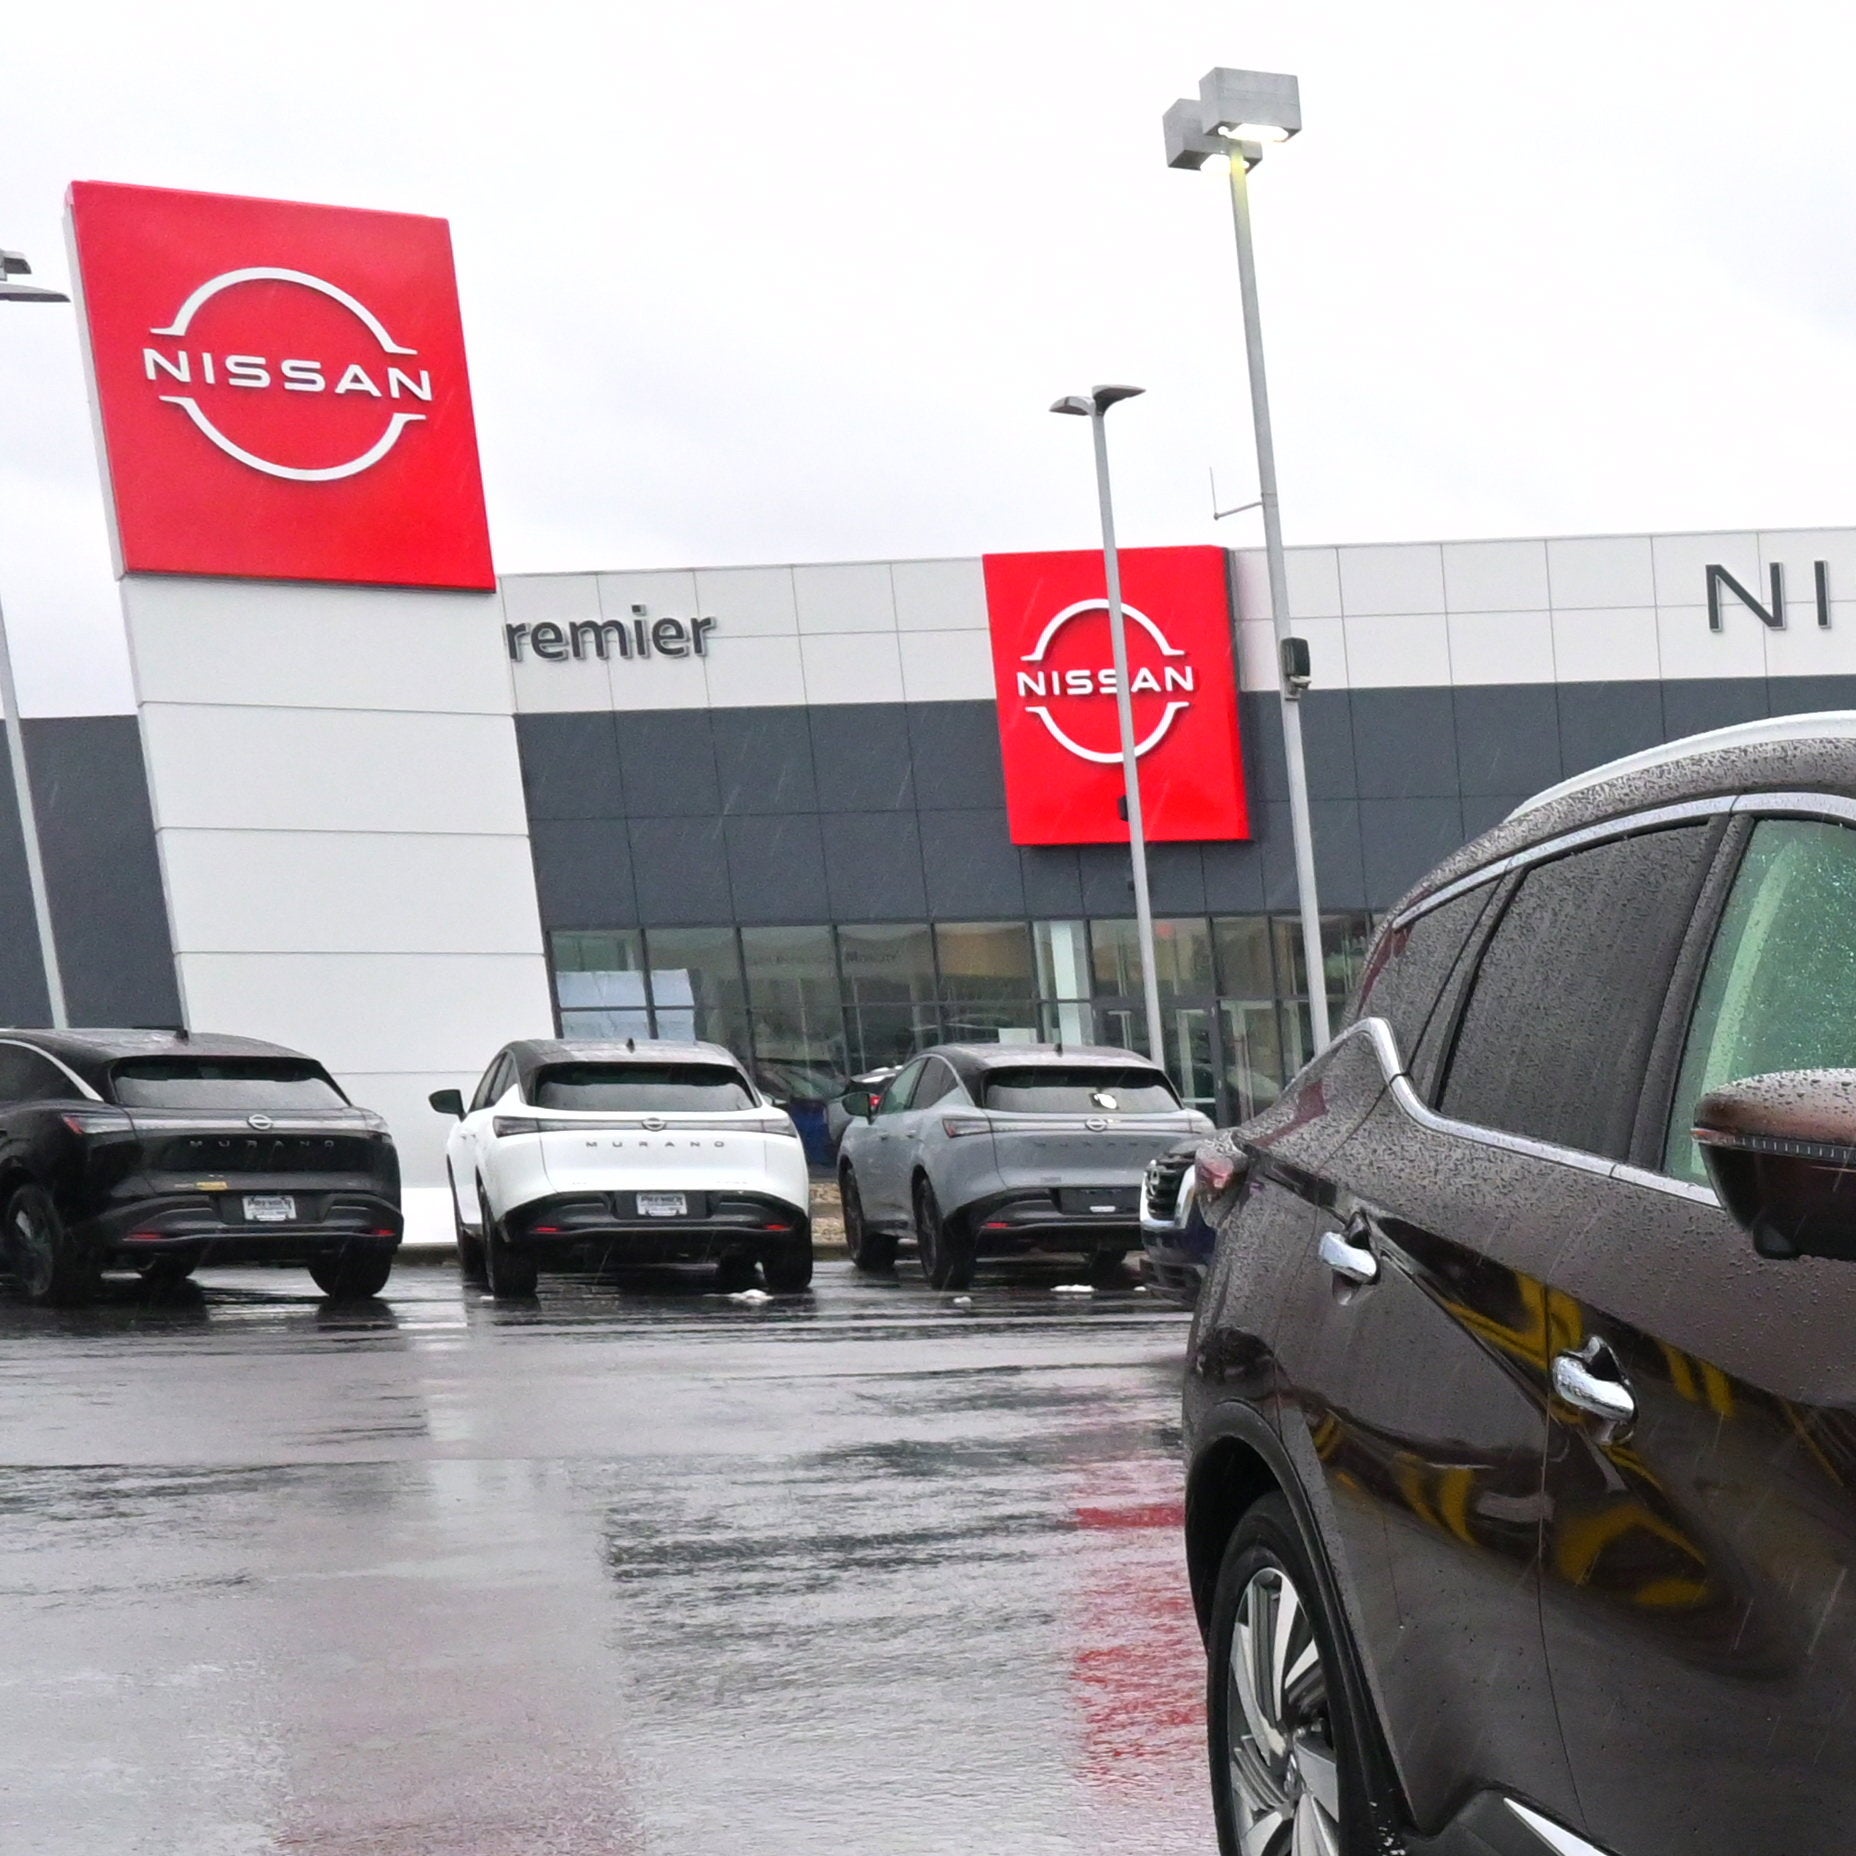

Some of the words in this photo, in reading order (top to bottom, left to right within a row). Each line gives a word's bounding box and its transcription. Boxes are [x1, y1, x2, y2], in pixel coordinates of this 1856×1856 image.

[143, 347, 432, 402] NISSAN
[505, 604, 716, 661] remier
[1016, 666, 1195, 697] NISSAN
[190, 1140, 335, 1149] MURANO
